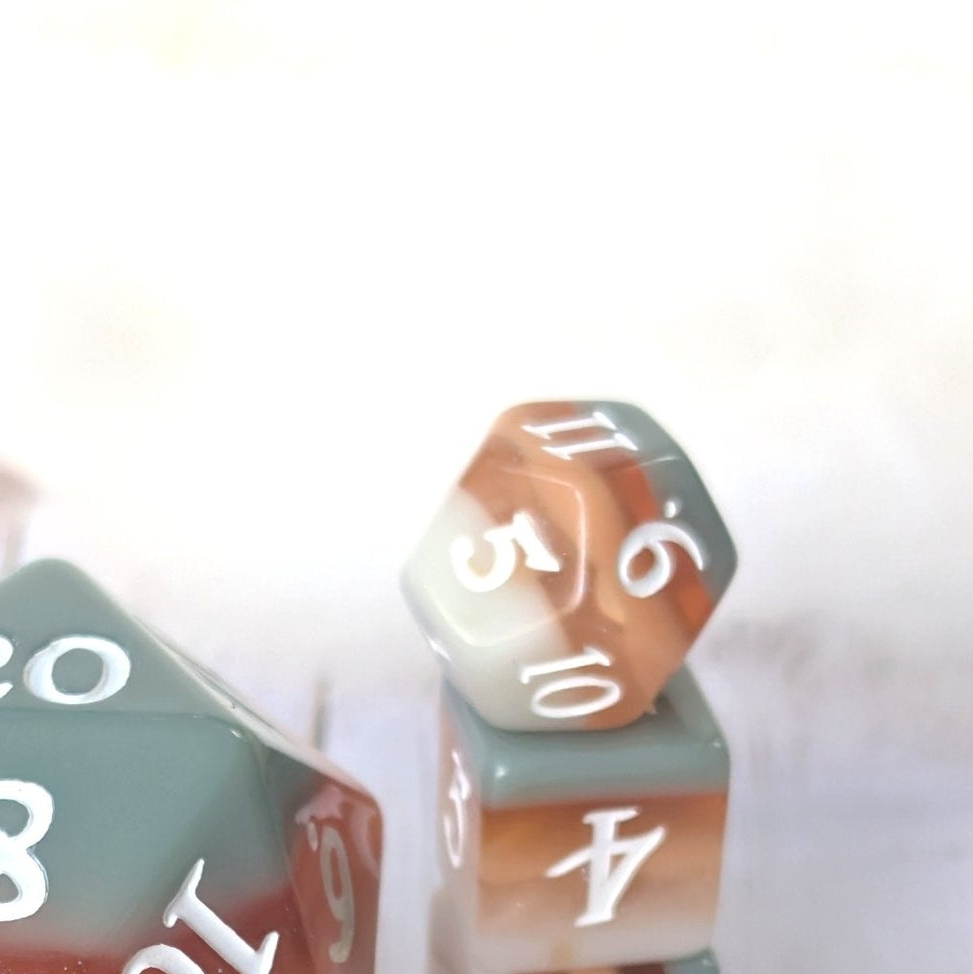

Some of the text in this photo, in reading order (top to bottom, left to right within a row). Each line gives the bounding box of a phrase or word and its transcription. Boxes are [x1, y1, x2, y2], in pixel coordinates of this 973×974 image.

[449, 510, 560, 593] 5
[520, 647, 621, 719] 10
[545, 806, 667, 927] 4
